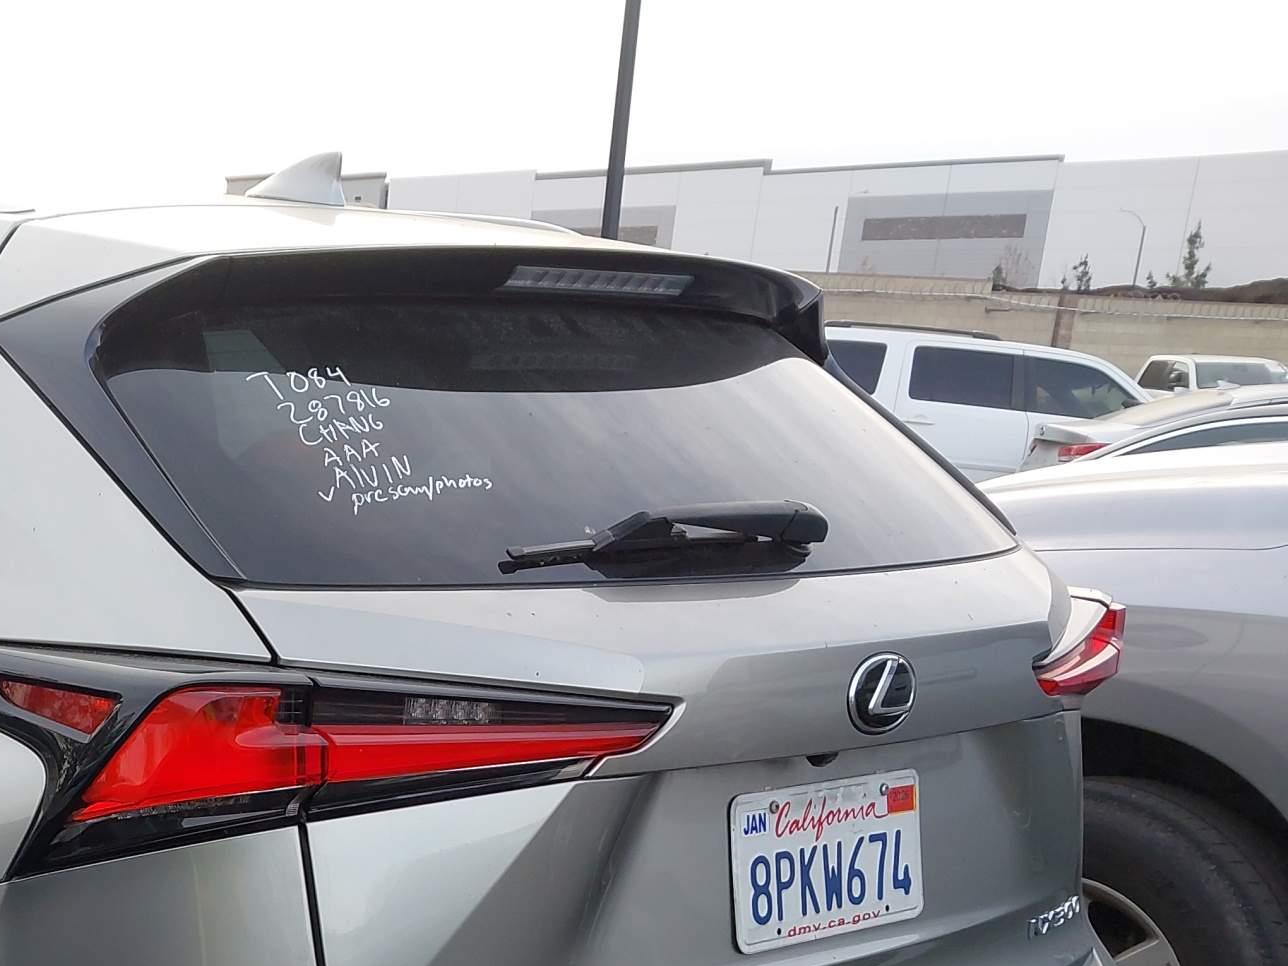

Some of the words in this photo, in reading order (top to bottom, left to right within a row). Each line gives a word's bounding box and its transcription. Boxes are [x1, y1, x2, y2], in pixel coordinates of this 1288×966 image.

[276, 387, 391, 424] 287816
[298, 413, 384, 446] CHANG
[323, 438, 381, 467] AAA
[743, 812, 767, 836] JAN
[775, 796, 889, 842] California
[750, 829, 912, 926] 8PKW674
[787, 909, 881, 938] dmv.ca.gov
